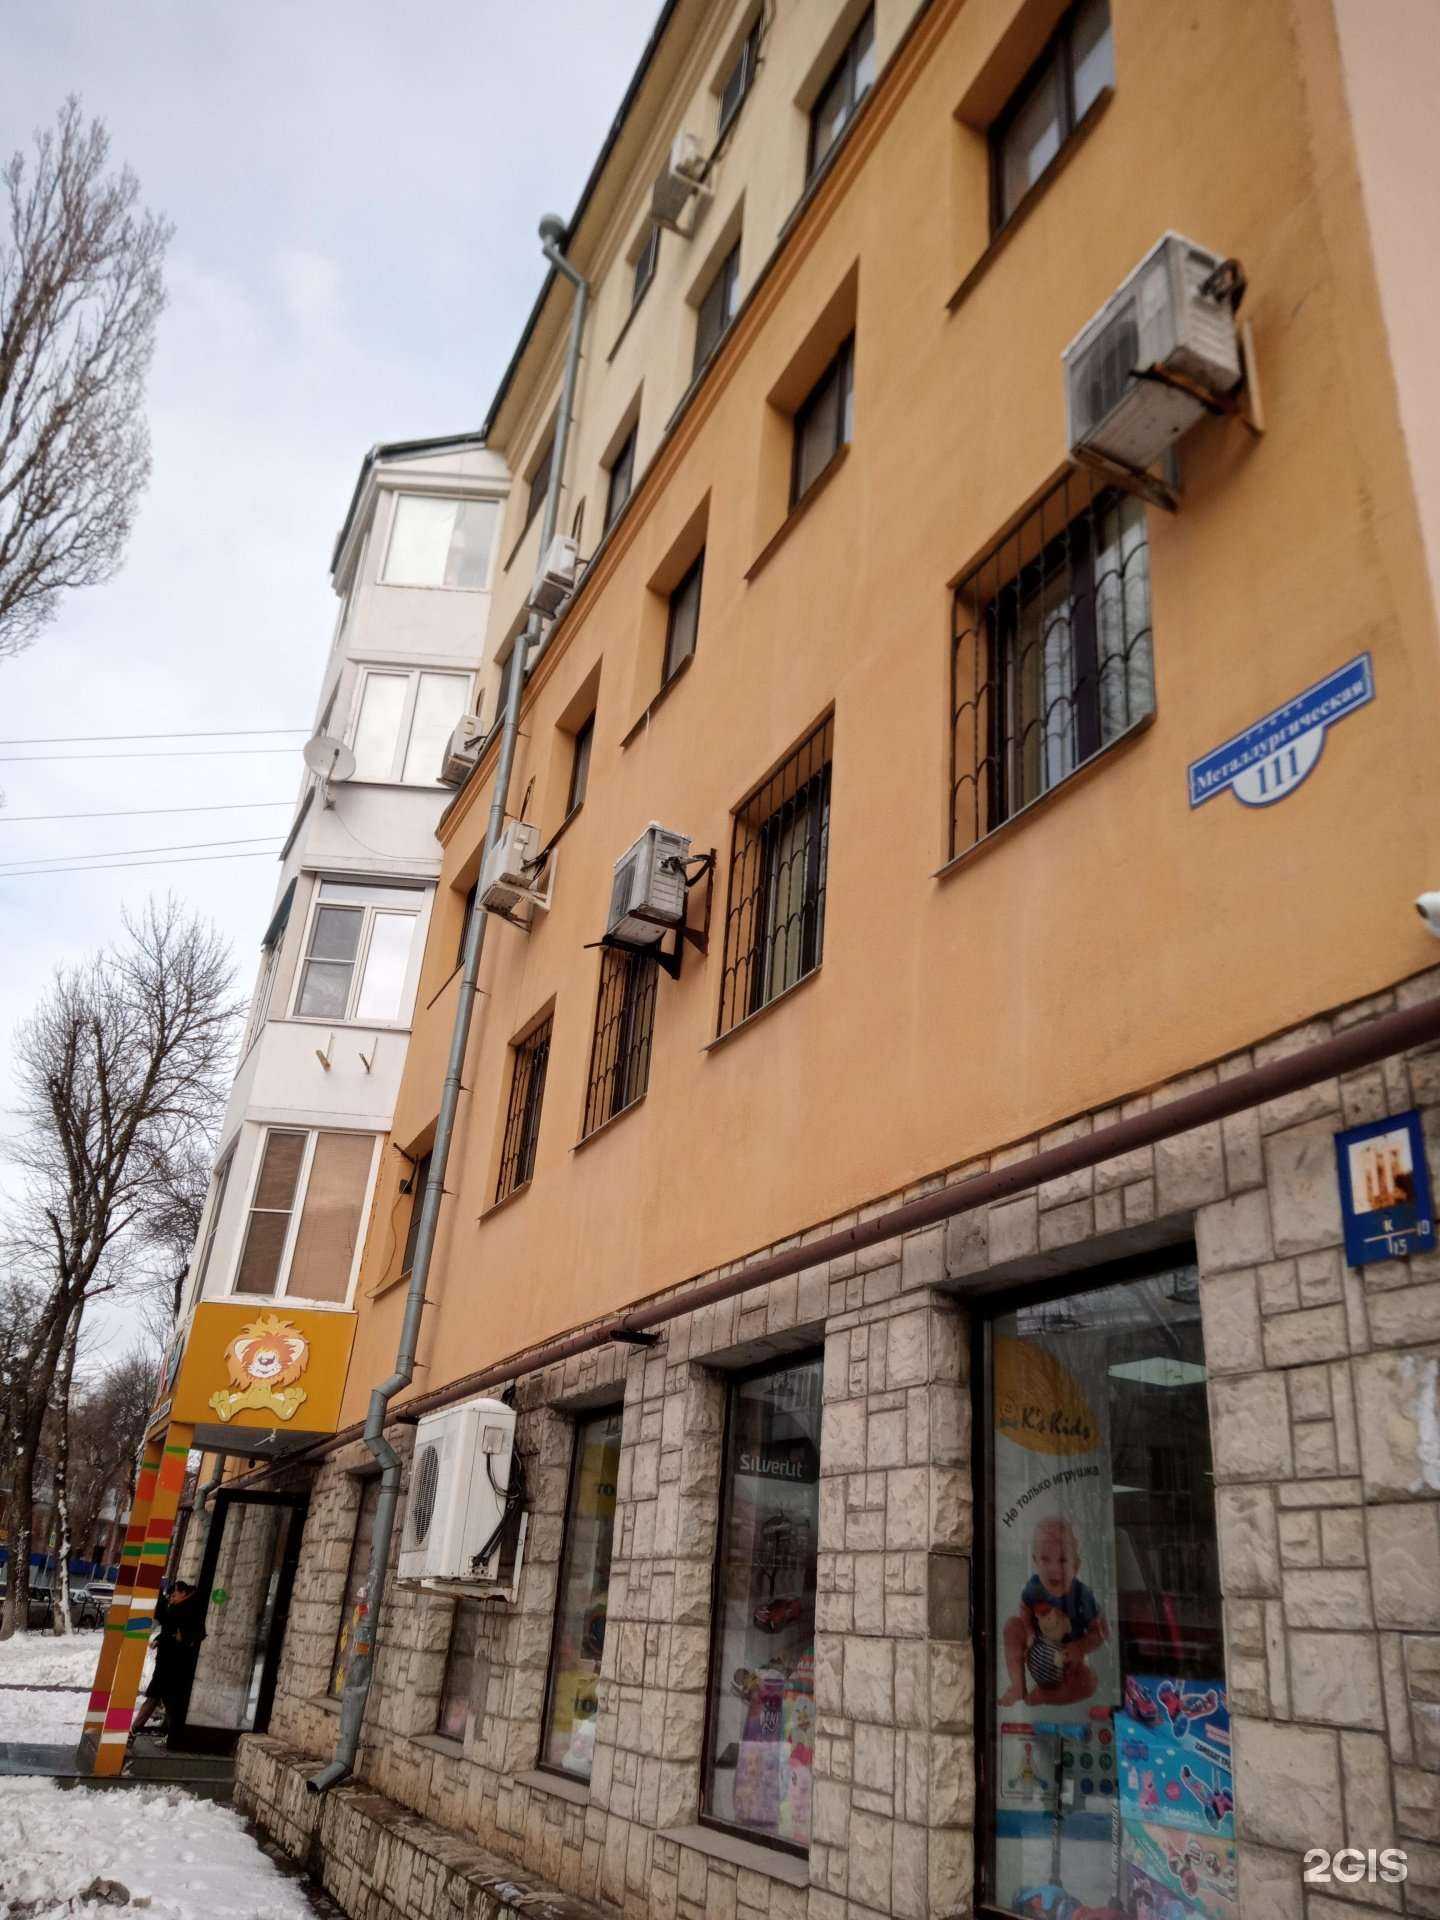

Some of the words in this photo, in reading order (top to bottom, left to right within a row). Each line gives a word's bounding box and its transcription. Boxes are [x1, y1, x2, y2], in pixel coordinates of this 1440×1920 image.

[1196, 680, 1364, 791] Металлургическая
[1257, 747, 1299, 796] 111
[739, 1454, 803, 1478] Silverlit
[1002, 1508, 1019, 1528] Не
[1016, 1479, 1052, 1509] только
